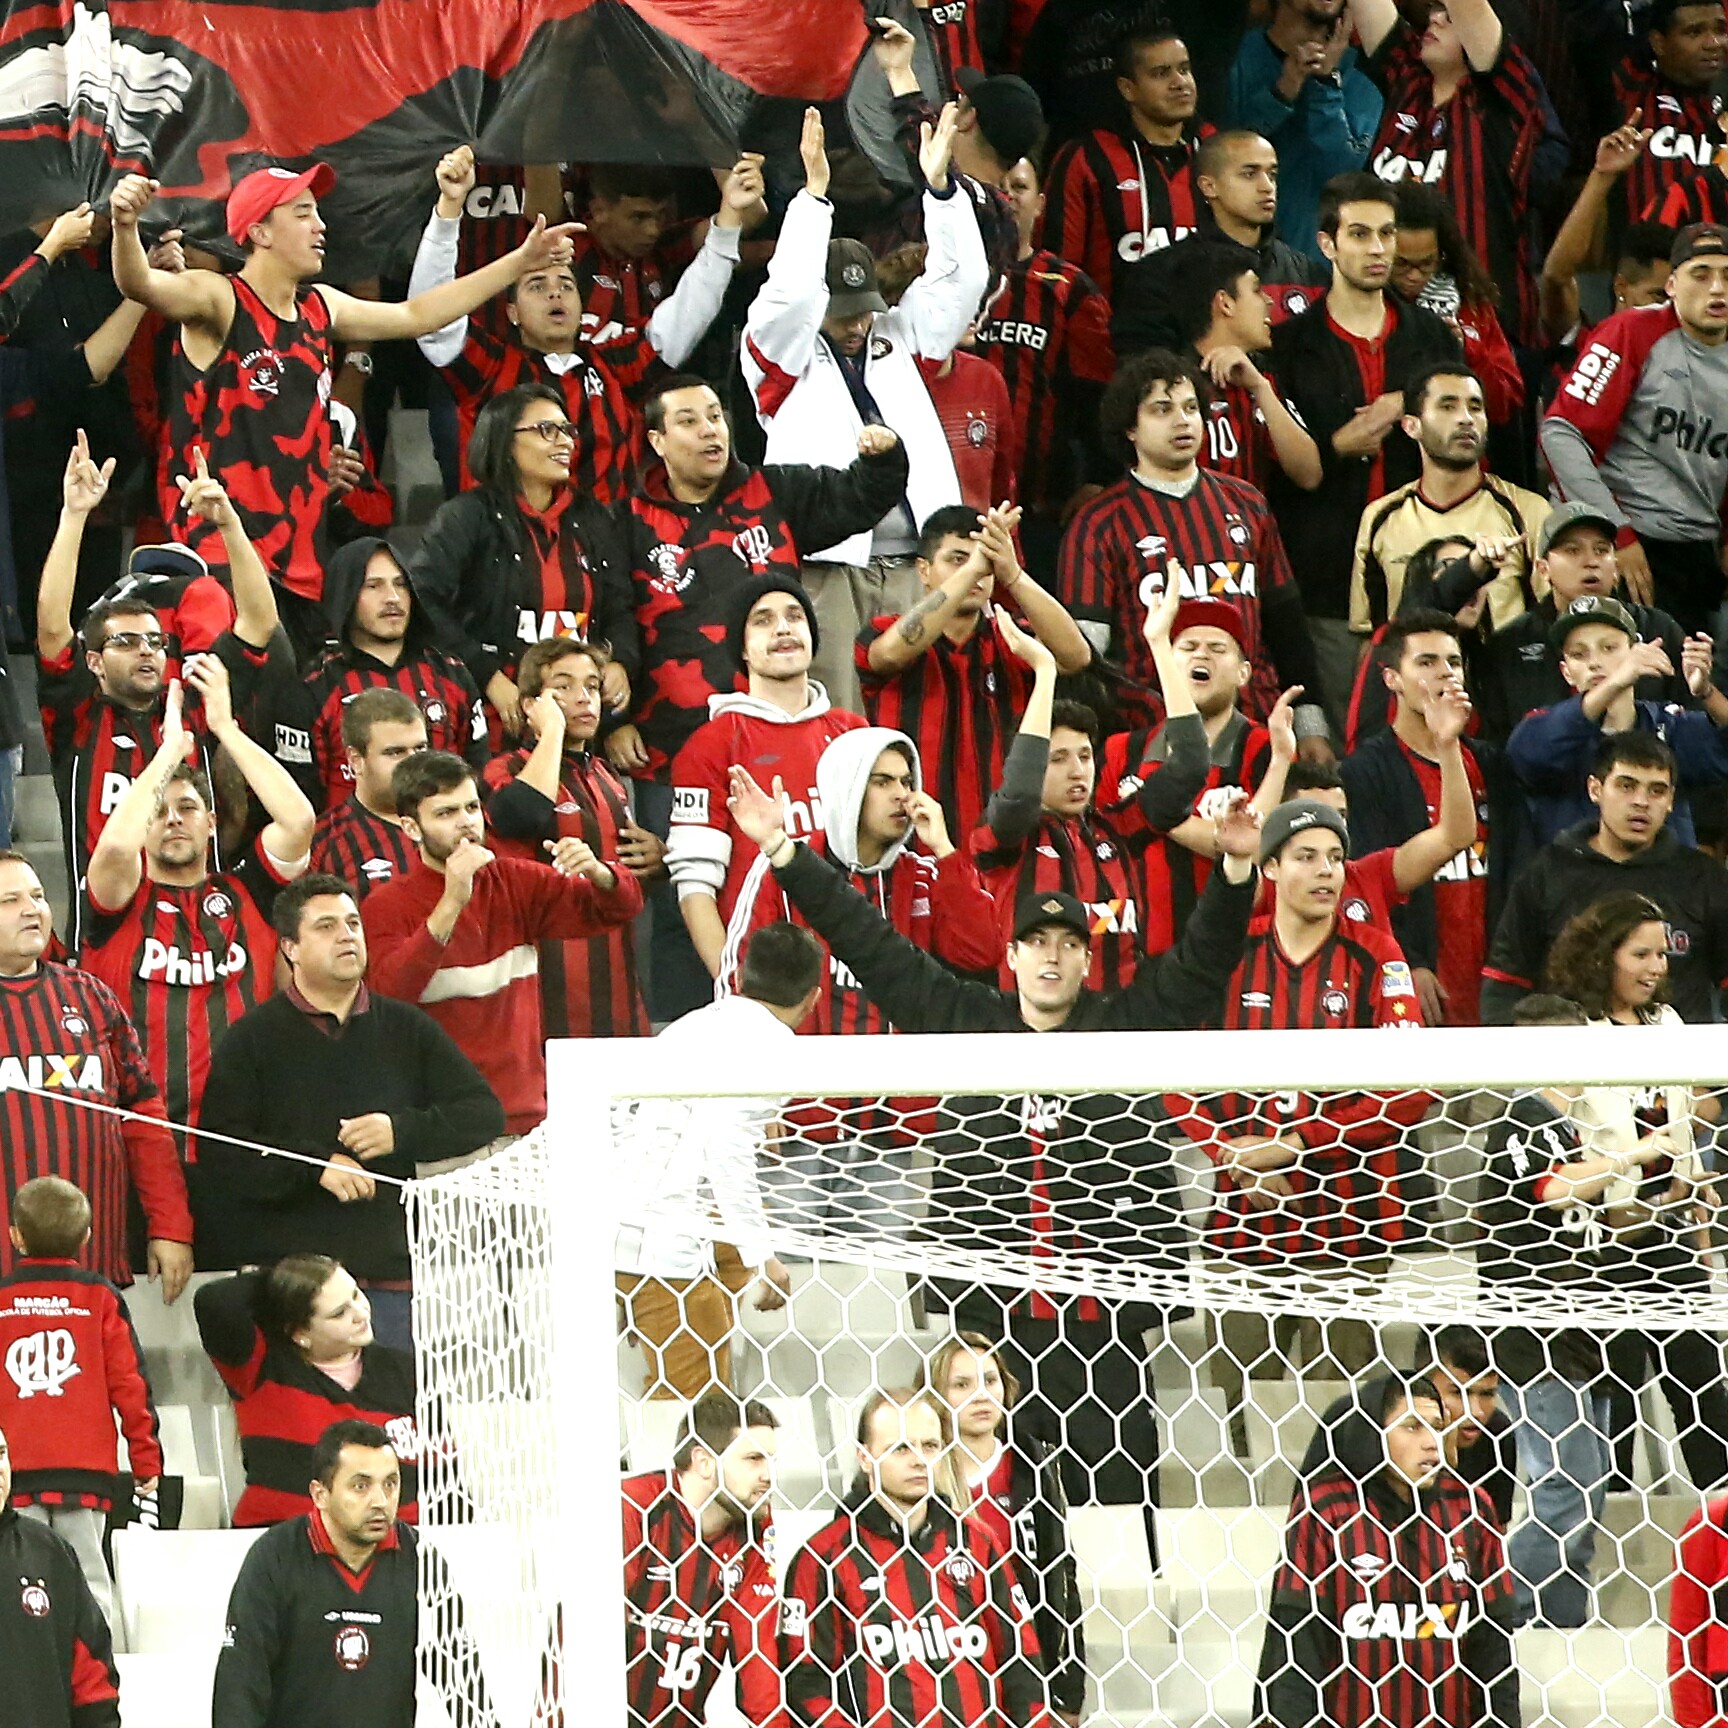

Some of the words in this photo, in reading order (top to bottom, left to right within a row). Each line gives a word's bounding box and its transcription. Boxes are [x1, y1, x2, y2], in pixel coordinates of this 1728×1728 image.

[1565, 342, 1611, 401] HDI
[1585, 352, 1622, 406] SEGUROS
[1207, 418, 1239, 460] 10
[277, 727, 310, 749] HDI
[673, 793, 705, 810] HDI
[864, 1617, 988, 1666] Philco
[658, 1641, 701, 1692] 16
